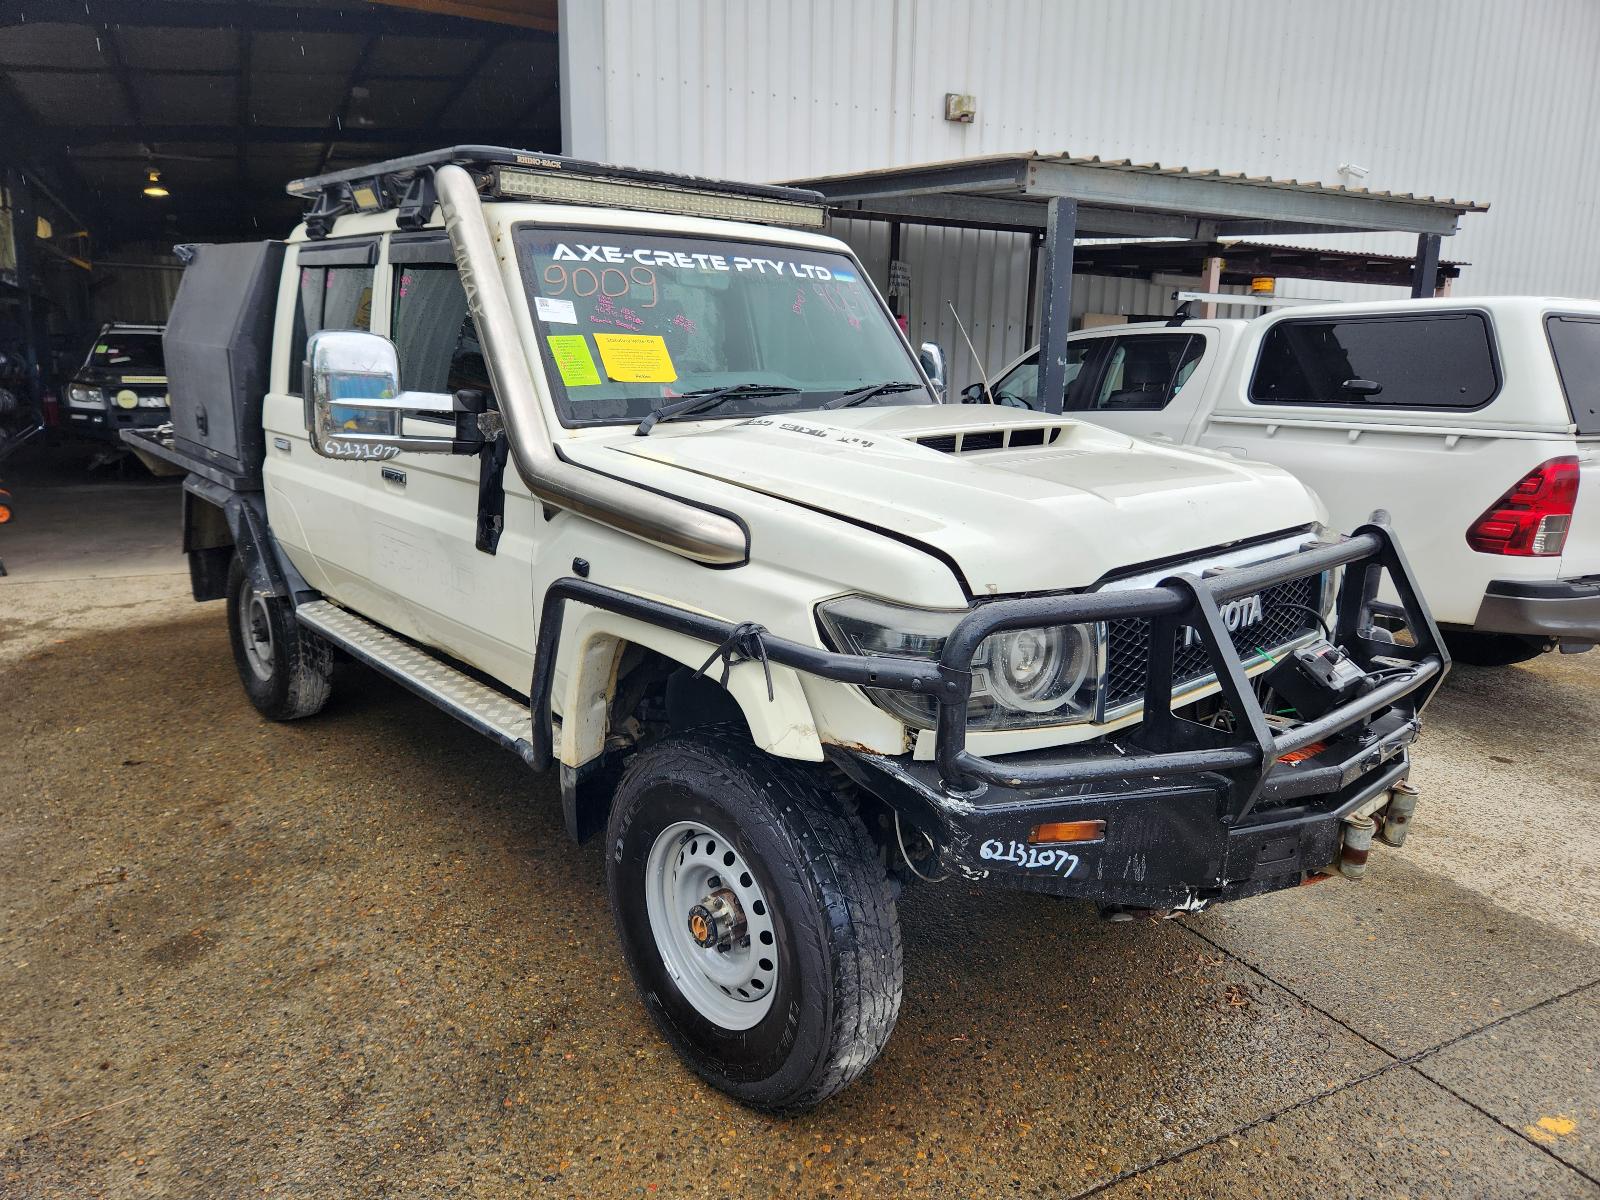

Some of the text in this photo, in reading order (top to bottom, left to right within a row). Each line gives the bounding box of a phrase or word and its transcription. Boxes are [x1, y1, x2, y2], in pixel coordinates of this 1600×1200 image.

[516, 155, 562, 169] RHINO-RACK
[552, 243, 832, 281] AXE-CRETE PTY LTD
[544, 264, 658, 308] 9009
[324, 440, 401, 458] 62131077
[1184, 594, 1264, 646] OTA
[979, 838, 1080, 878] 62131077
